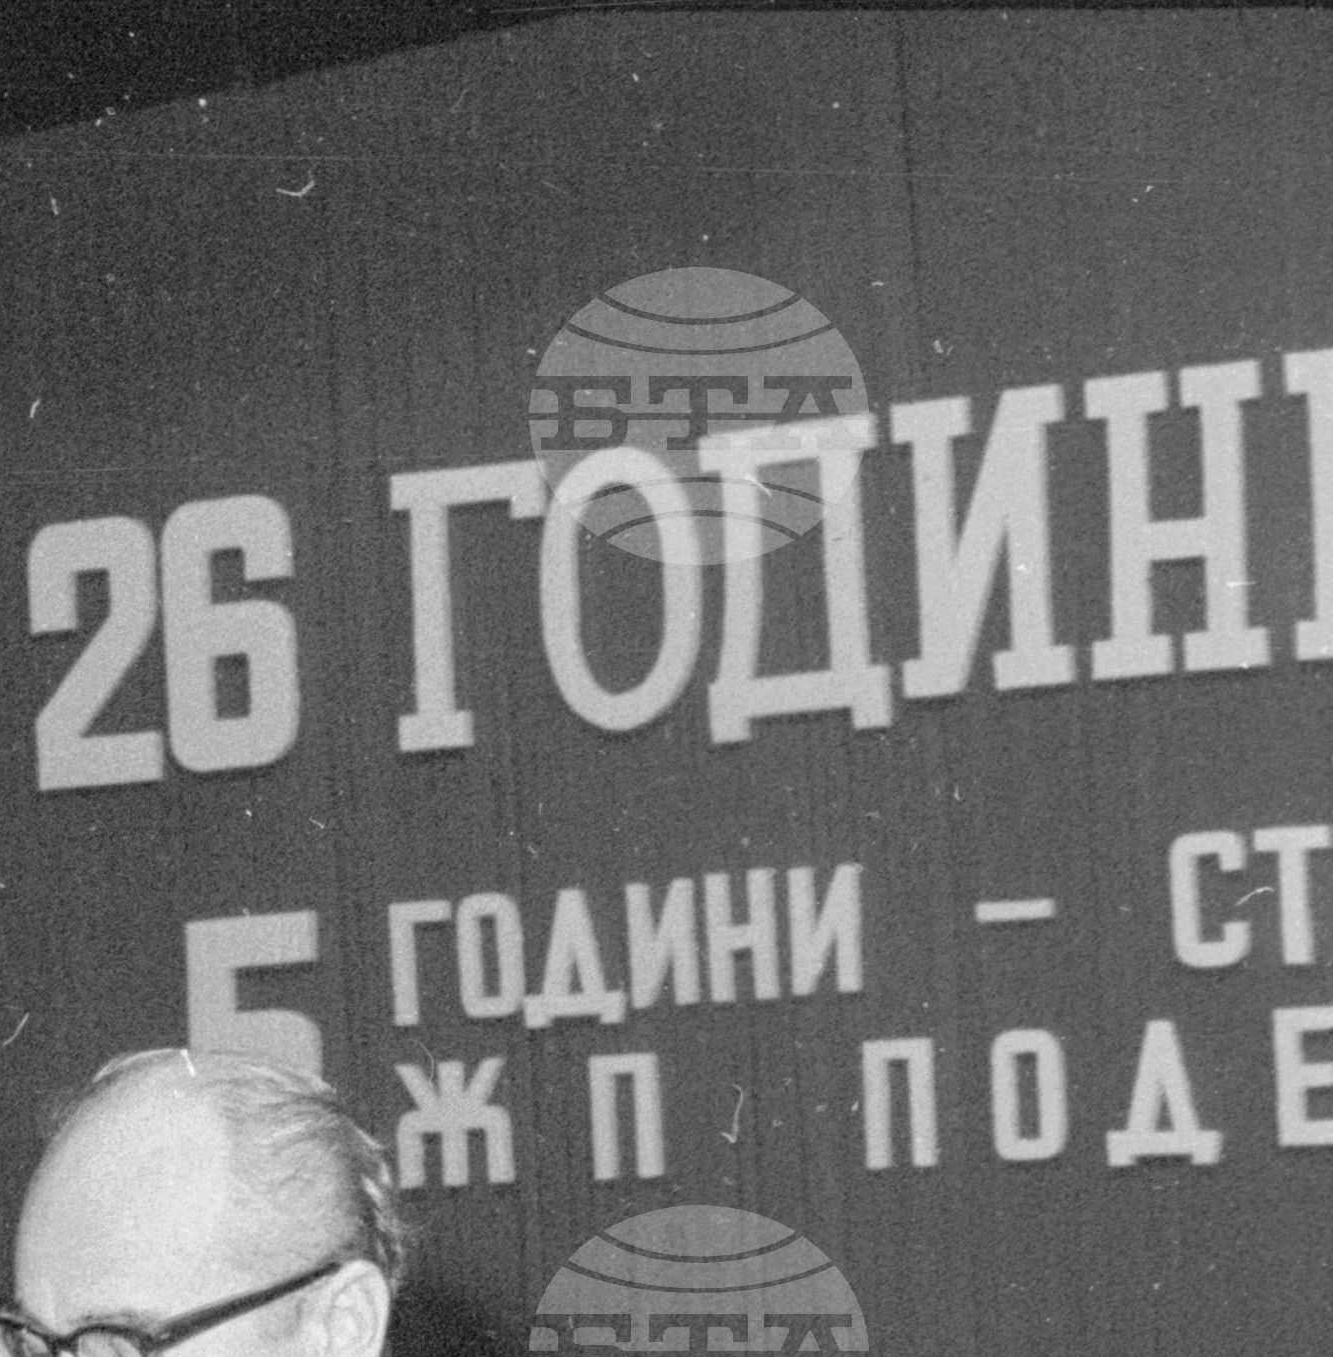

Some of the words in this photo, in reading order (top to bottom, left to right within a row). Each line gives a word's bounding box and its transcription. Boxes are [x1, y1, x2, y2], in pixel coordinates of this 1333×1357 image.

[27, 494, 300, 791] 26
[389, 349, 1333, 752] ГОДИН
[389, 863, 863, 1028] ГОДИНИ
[1169, 824, 1331, 968] СТ
[861, 1005, 1333, 1170] ПОДЕ
